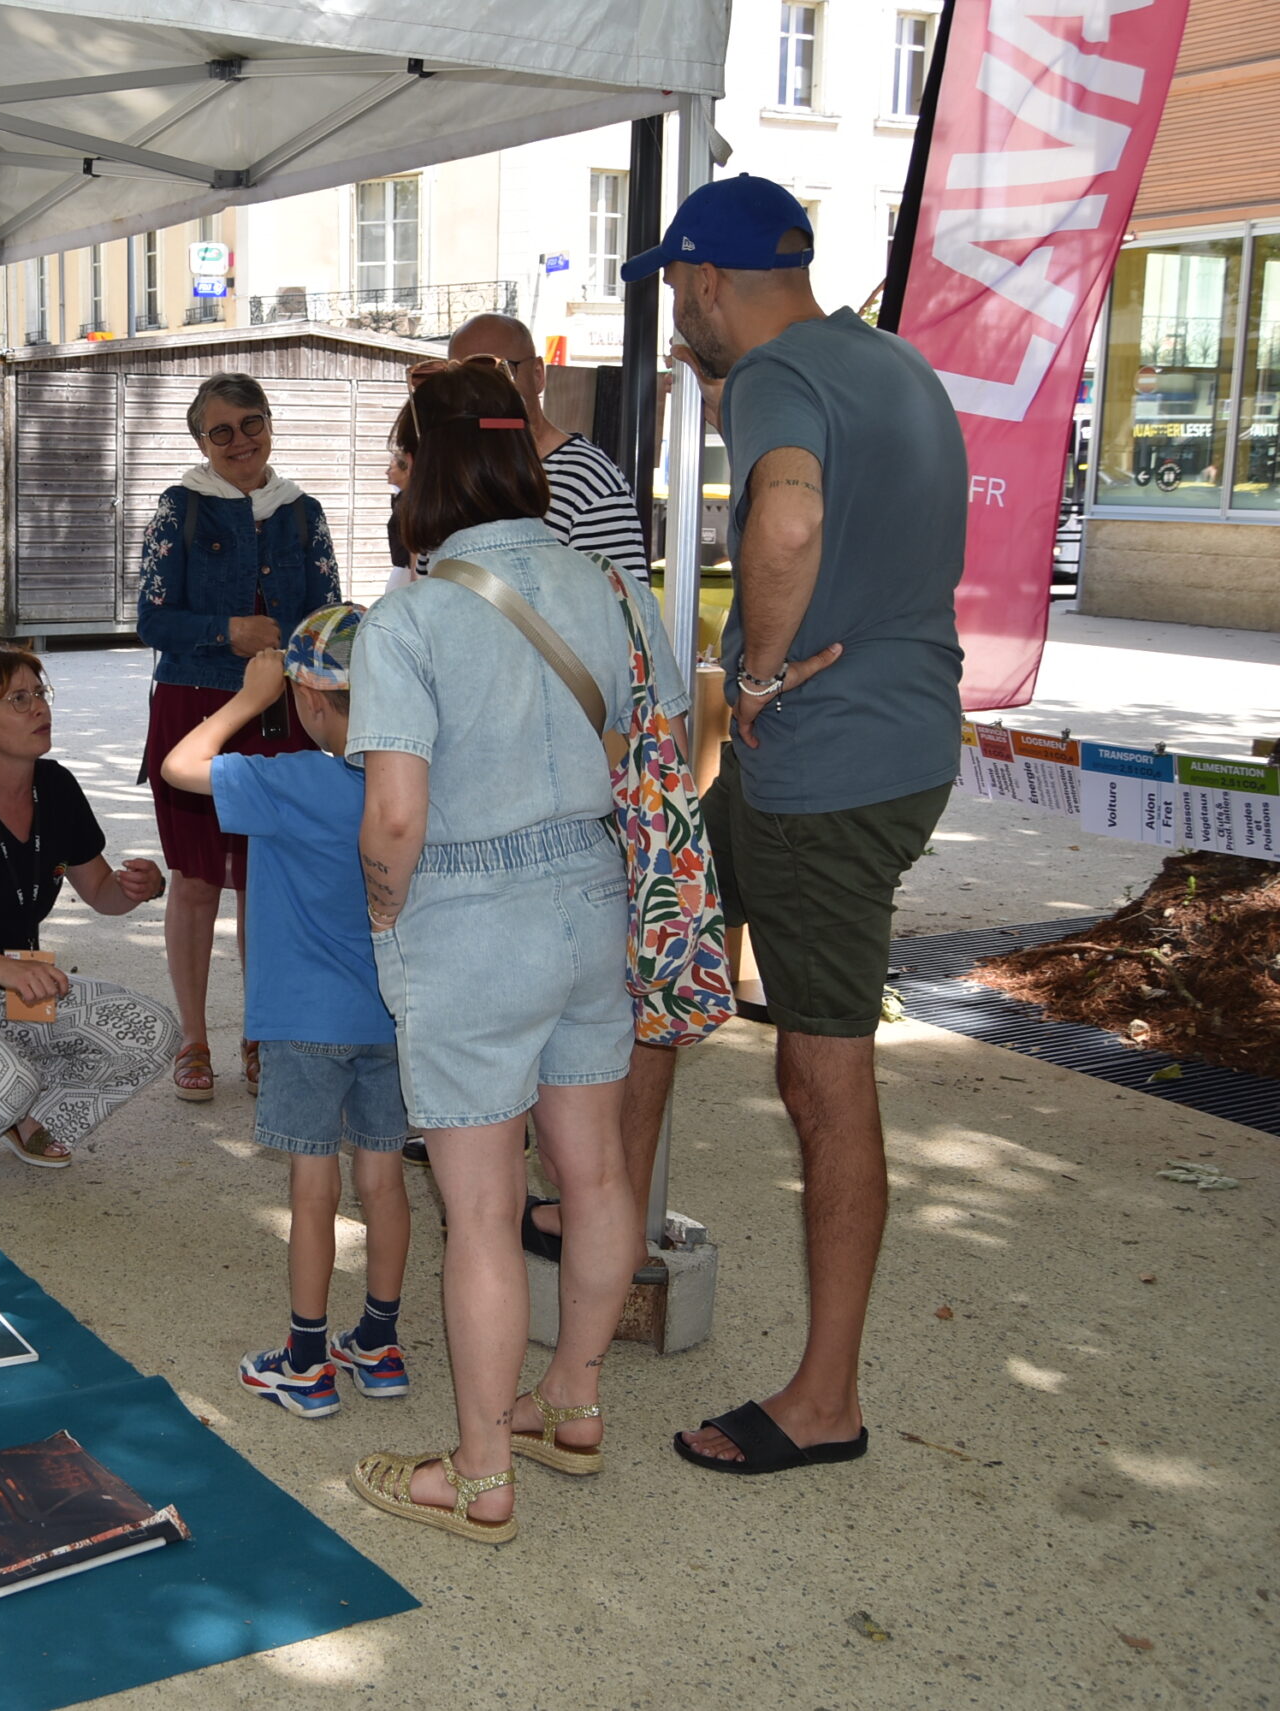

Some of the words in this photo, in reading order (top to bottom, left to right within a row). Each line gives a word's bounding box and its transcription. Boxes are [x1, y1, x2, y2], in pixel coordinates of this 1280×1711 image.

[968, 474, 1007, 508] FR
[1099, 748, 1154, 765] TRANSPORT
[1190, 761, 1265, 778] ALIMENTATION
[1023, 761, 1039, 805] Énergie
[1059, 766, 1074, 815] Construction
[1107, 781, 1118, 828] Voiture
[1145, 792, 1156, 831] Avion
[1162, 800, 1173, 828] Fret
[1183, 791, 1193, 839] Boissons
[1200, 792, 1211, 842] Végétaux
[1244, 802, 1255, 846] Viandes
[1254, 820, 1263, 832] et
[1262, 802, 1273, 852] Poissons
